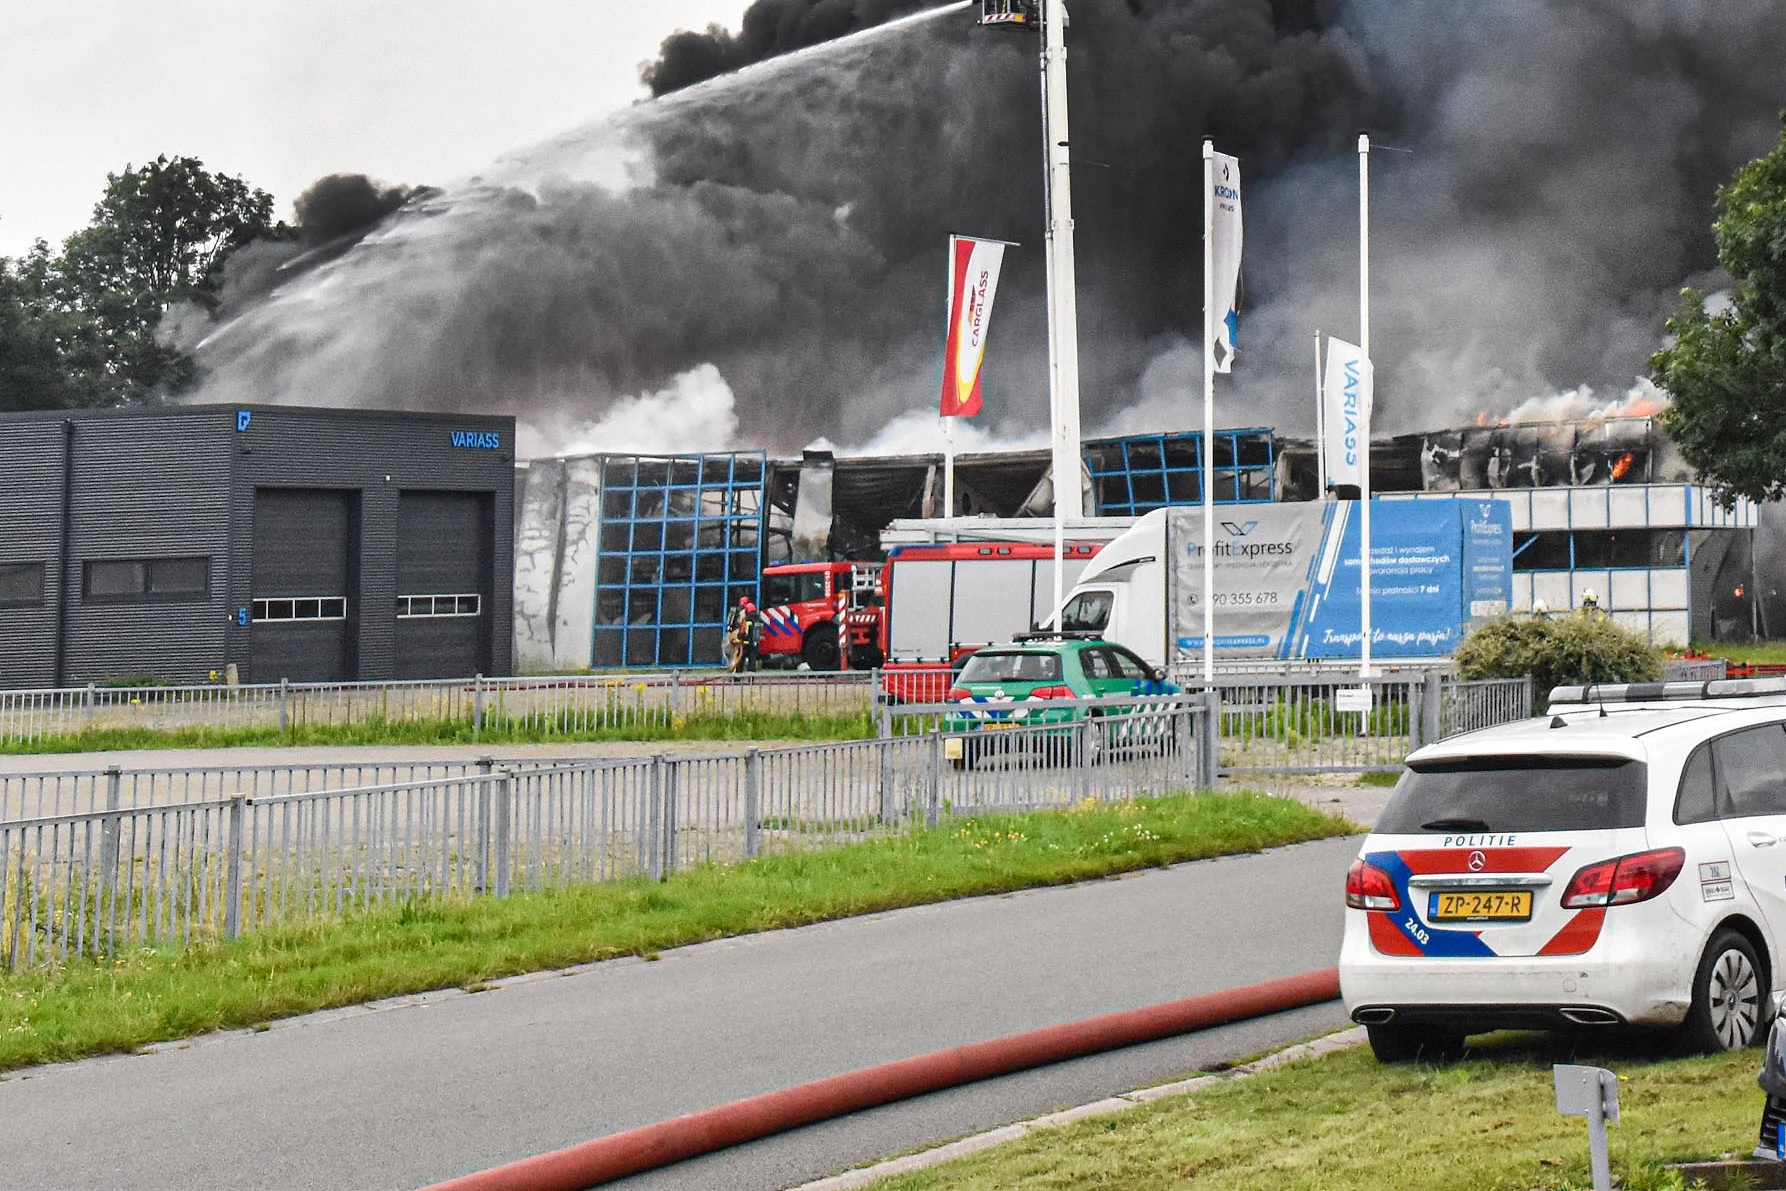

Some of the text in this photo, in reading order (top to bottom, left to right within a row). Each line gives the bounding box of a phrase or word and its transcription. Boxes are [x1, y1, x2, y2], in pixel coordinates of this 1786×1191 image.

[971, 270, 989, 346] CARGLASS
[1344, 360, 1360, 466] VARIASS
[450, 430, 500, 449] VARIASS
[1186, 541, 1292, 559] PrfitExpress
[1230, 592, 1253, 604] 355
[1255, 591, 1278, 604] 678
[1420, 585, 1425, 593] 7
[1426, 585, 1440, 594] dni
[237, 608, 248, 626] 5
[1443, 835, 1517, 847] POLITIE
[1443, 896, 1521, 915] ZP-247-R
[1404, 917, 1430, 946] 24.03
